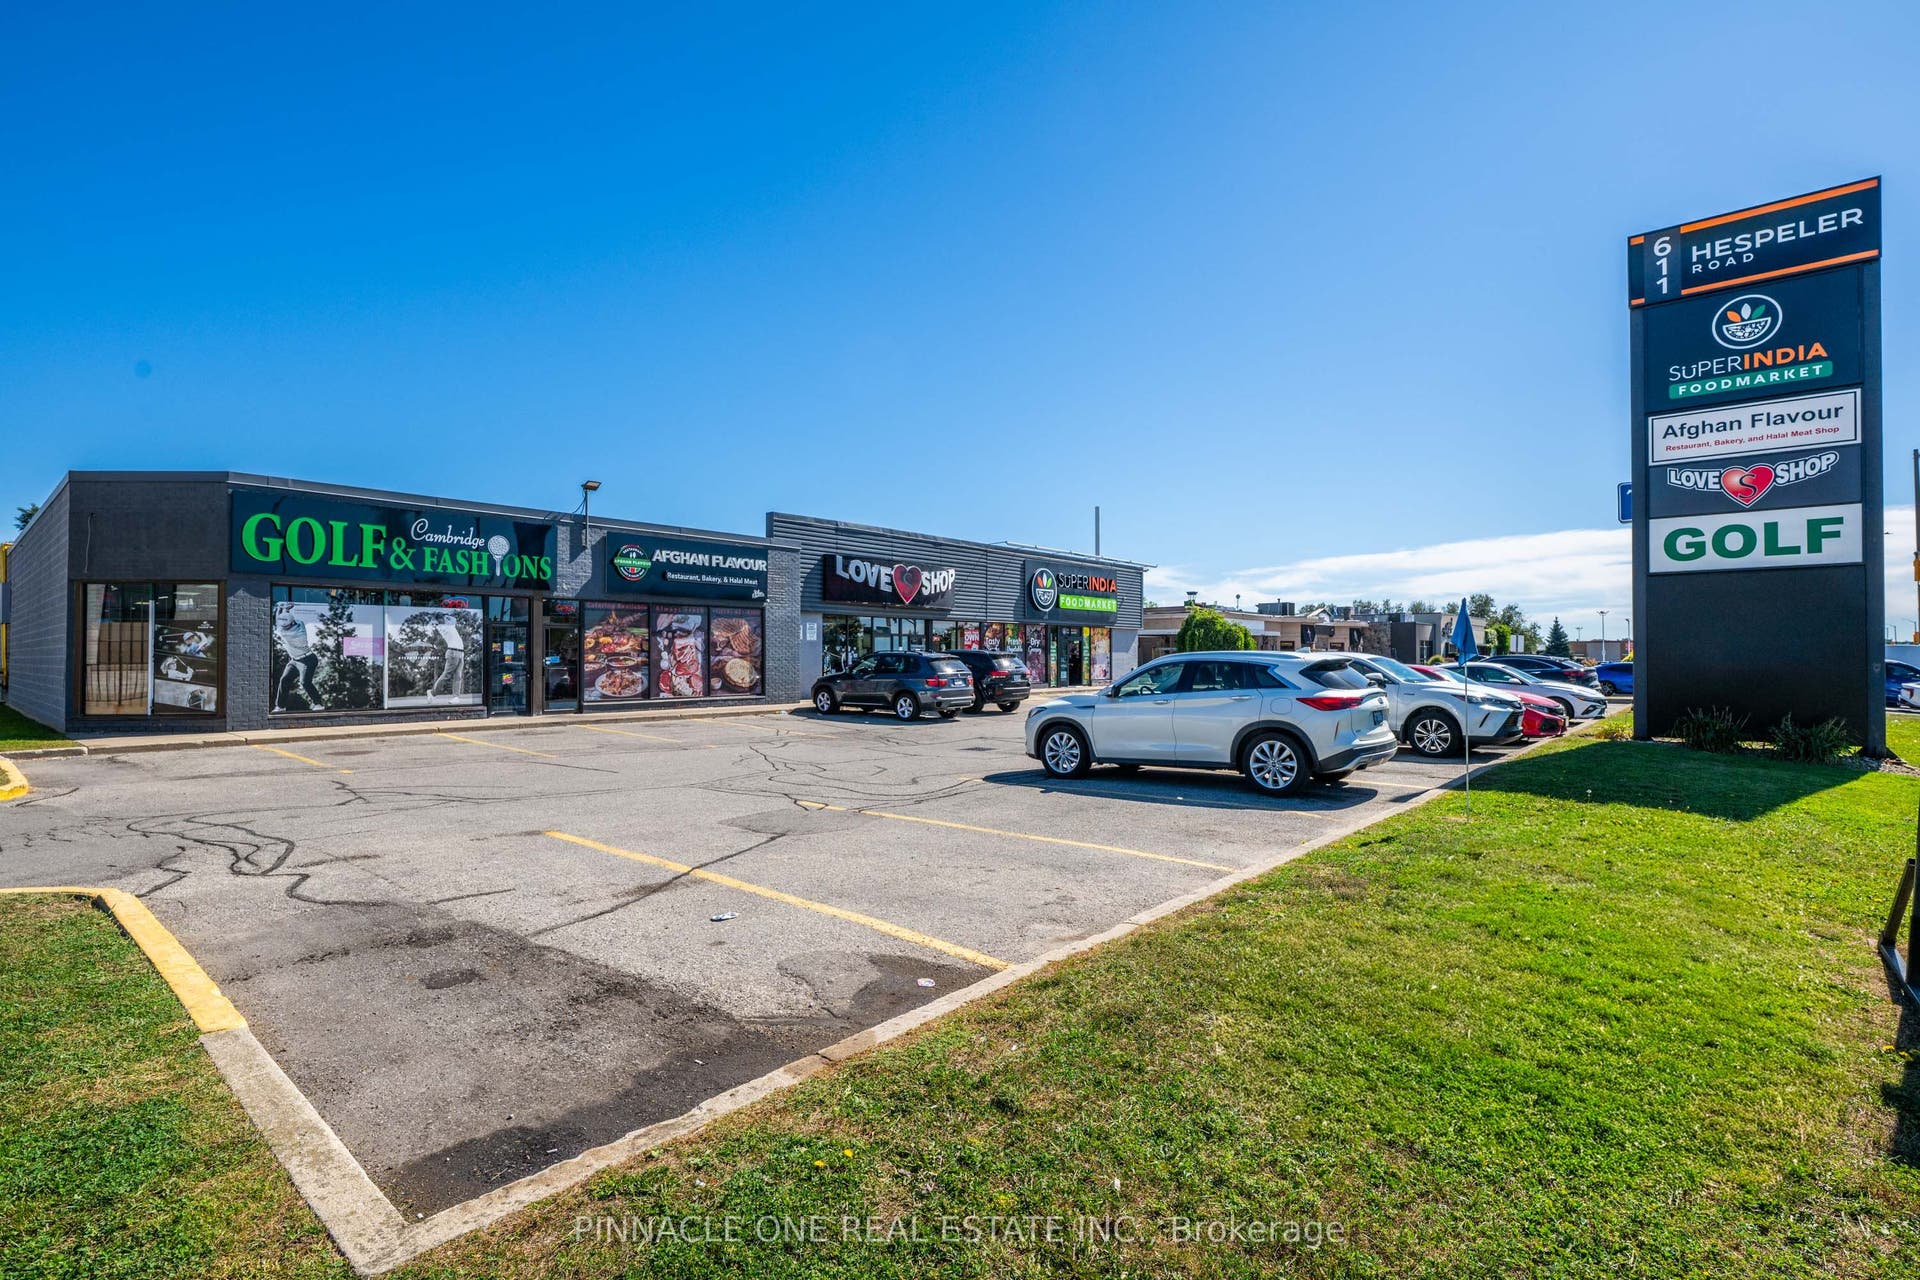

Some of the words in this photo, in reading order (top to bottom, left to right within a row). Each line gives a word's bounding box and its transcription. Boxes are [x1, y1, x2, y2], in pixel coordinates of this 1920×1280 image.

[1692, 207, 1863, 262] HESPELER
[1692, 253, 1754, 274] ROAD
[1678, 364, 1823, 395] FOODMARKET
[1662, 419, 1742, 439] Afghan
[1751, 406, 1844, 428] Flavour
[1665, 441, 1712, 451] Restaurant,
[1714, 438, 1745, 447] Bakery,
[1766, 432, 1788, 440] Halal
[1791, 429, 1812, 437] Meat
[1815, 426, 1840, 434] Shop
[1668, 467, 1721, 491] LOVE
[1775, 451, 1838, 484] SHOP
[242, 512, 387, 568] GOLF
[389, 537, 416, 571] &
[410, 518, 485, 548] Cambridge
[1663, 516, 1844, 562] GOLF
[652, 549, 710, 566] AFGHAN
[711, 555, 767, 571] FLAVOUR
[836, 555, 892, 592] LOVE
[921, 568, 955, 596] SHOP
[666, 572, 700, 581] Restaurant,
[441, 599, 469, 608] OPEN
